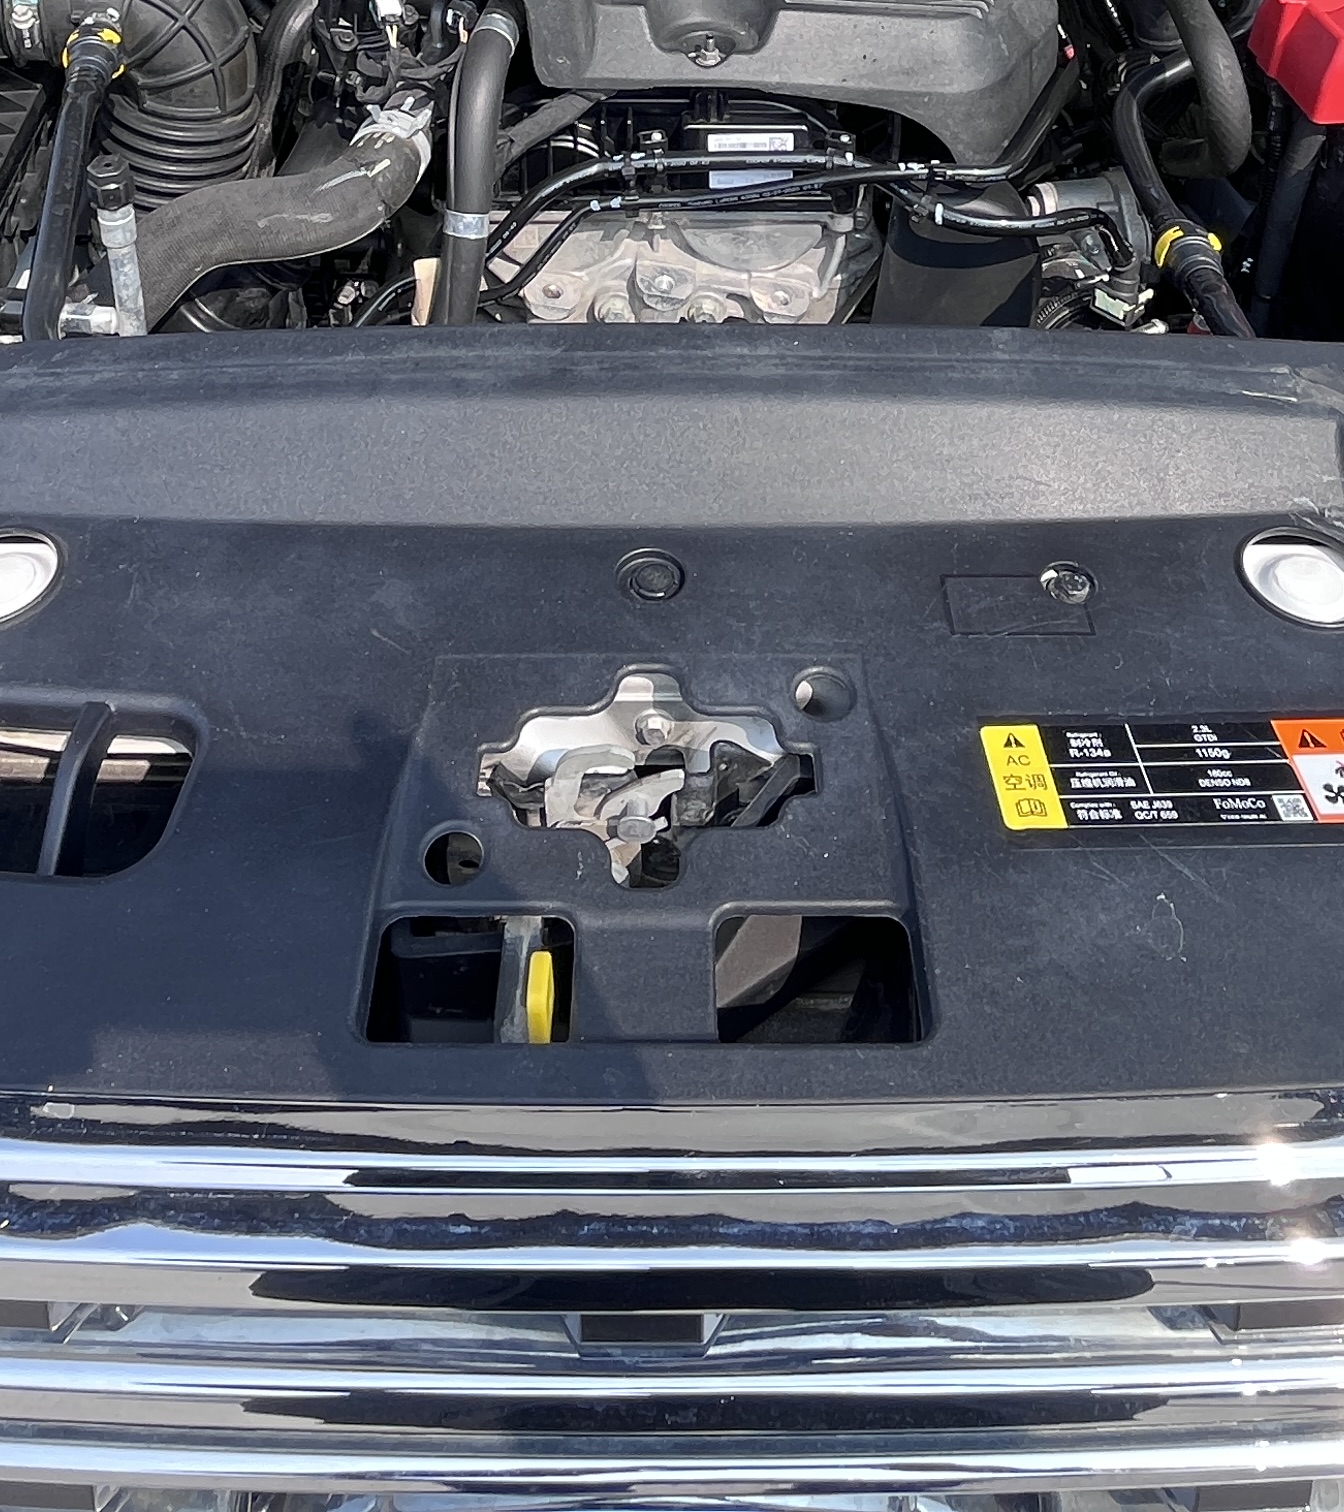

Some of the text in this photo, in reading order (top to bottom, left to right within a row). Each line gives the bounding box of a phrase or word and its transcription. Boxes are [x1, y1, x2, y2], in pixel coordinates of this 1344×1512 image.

[1069, 748, 1112, 758] R-134a
[1195, 748, 1231, 759] 1150g
[1006, 755, 1031, 766] AC
[1003, 773, 1048, 790] 空调
[1198, 778, 1231, 787] DENSO
[1213, 797, 1266, 810] FoMoCo
